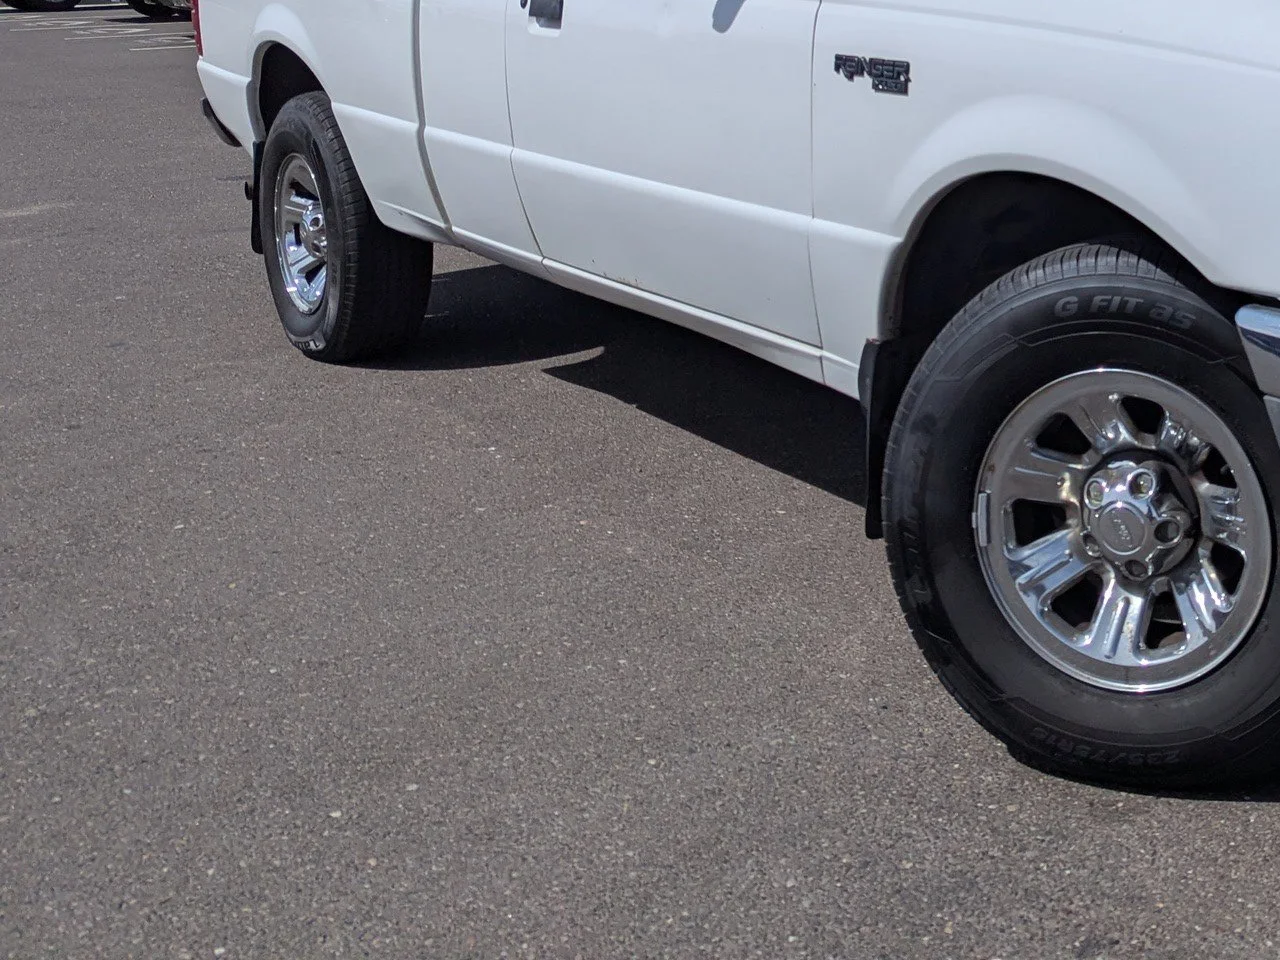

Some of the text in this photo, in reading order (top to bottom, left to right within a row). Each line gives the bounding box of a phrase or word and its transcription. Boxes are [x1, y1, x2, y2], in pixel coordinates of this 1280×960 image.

[834, 54, 912, 82] RANGER
[1054, 295, 1079, 318] G
[1090, 295, 1144, 314] FIT
